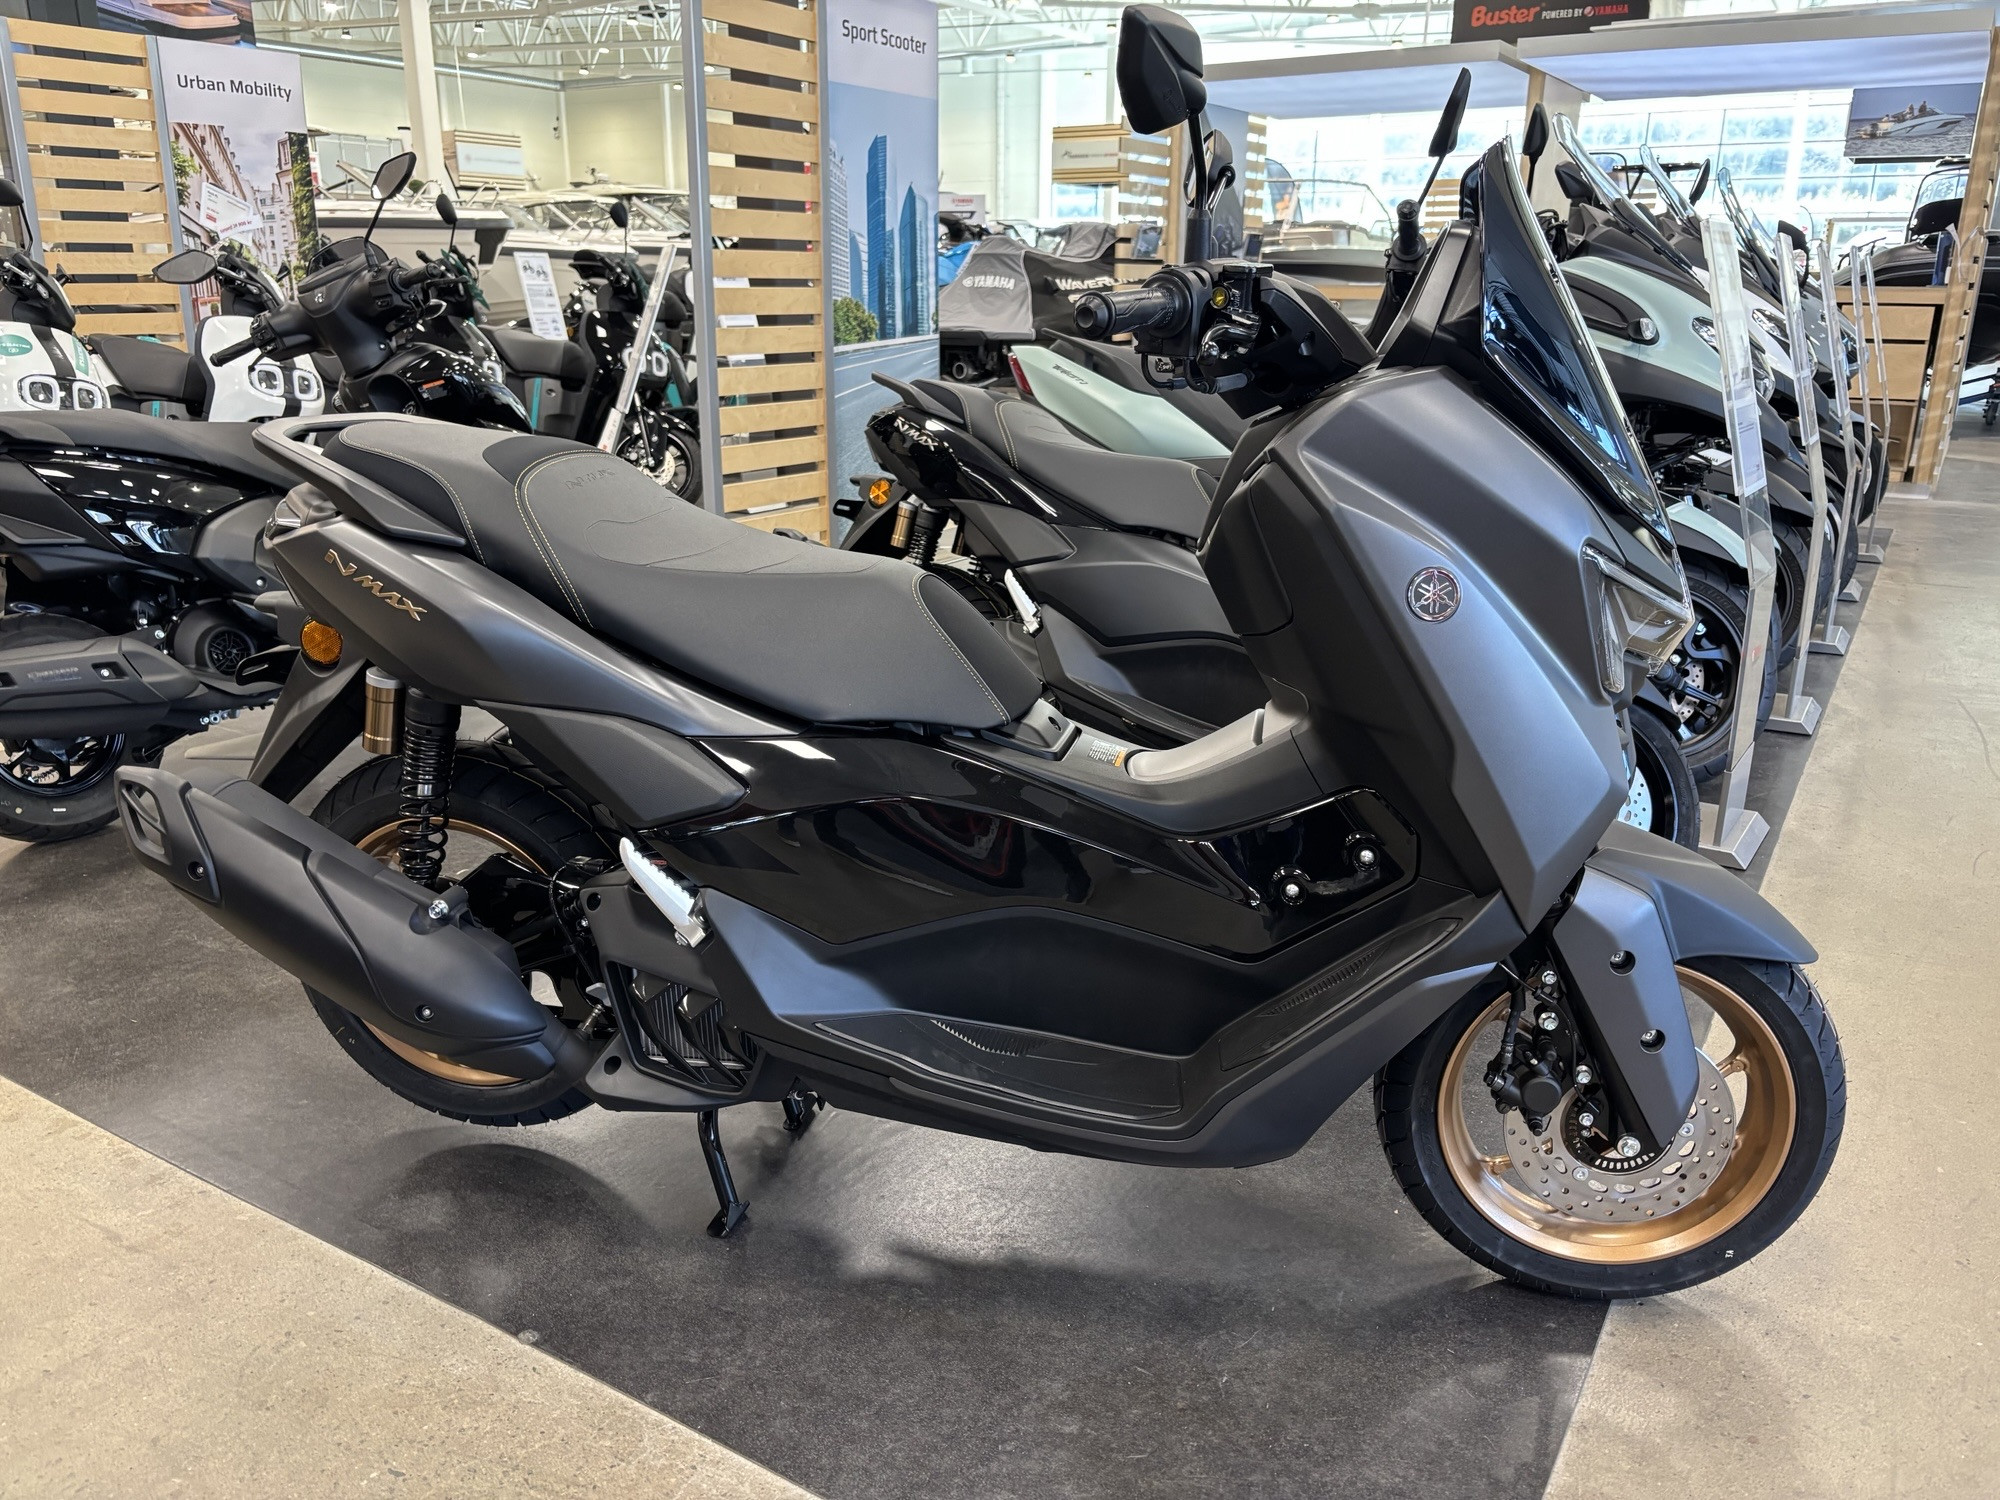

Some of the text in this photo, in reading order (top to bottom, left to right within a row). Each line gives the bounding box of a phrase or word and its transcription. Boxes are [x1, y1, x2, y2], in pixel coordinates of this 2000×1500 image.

[1471, 4, 1629, 27] Buster POWERED BY YAMAHA
[842, 19, 927, 54] Sport Scooter
[176, 73, 292, 102] Urban Mobility
[973, 275, 1016, 290] YAMAHA
